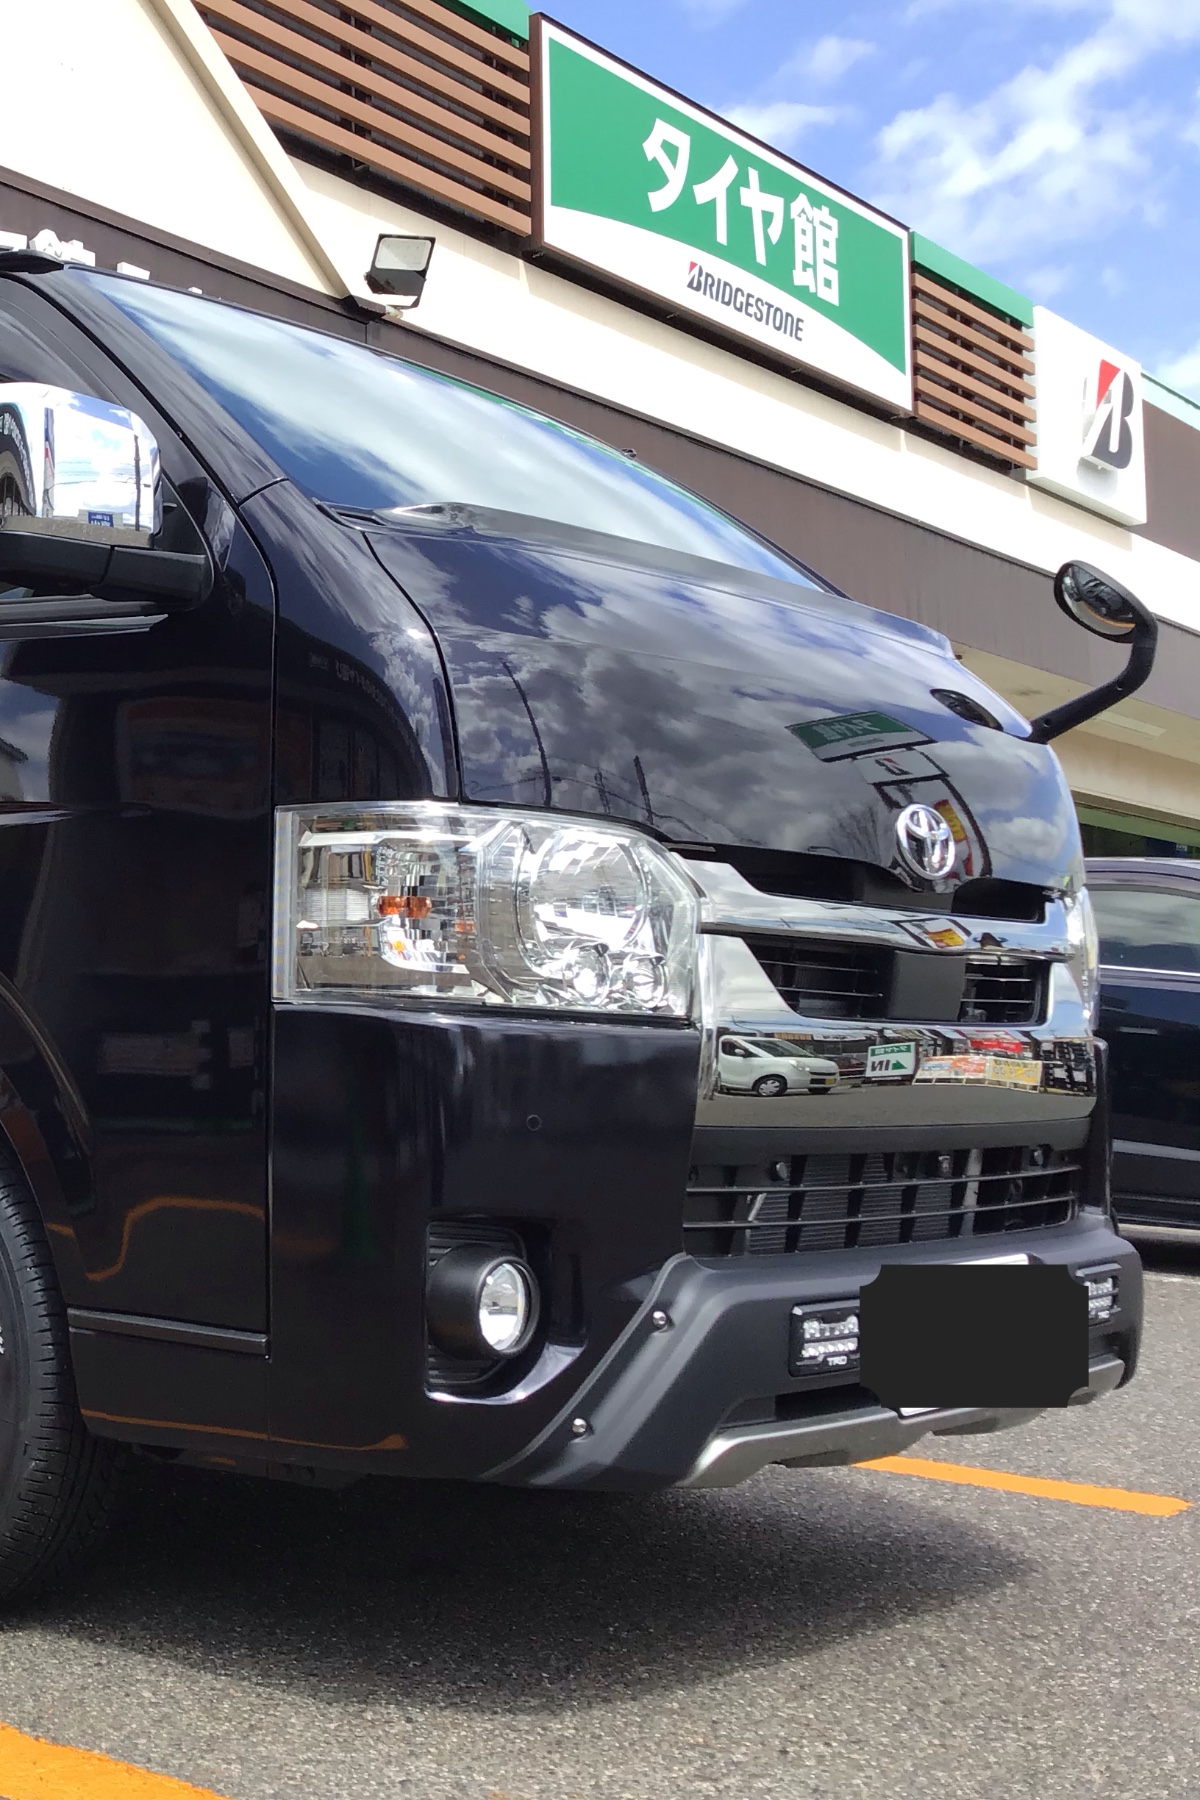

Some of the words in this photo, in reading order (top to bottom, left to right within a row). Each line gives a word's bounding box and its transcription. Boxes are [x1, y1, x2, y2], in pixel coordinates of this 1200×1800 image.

[641, 117, 840, 307] タイヤ館
[686, 260, 805, 342] BRIDGESTONE
[826, 1355, 848, 1366] TRD
